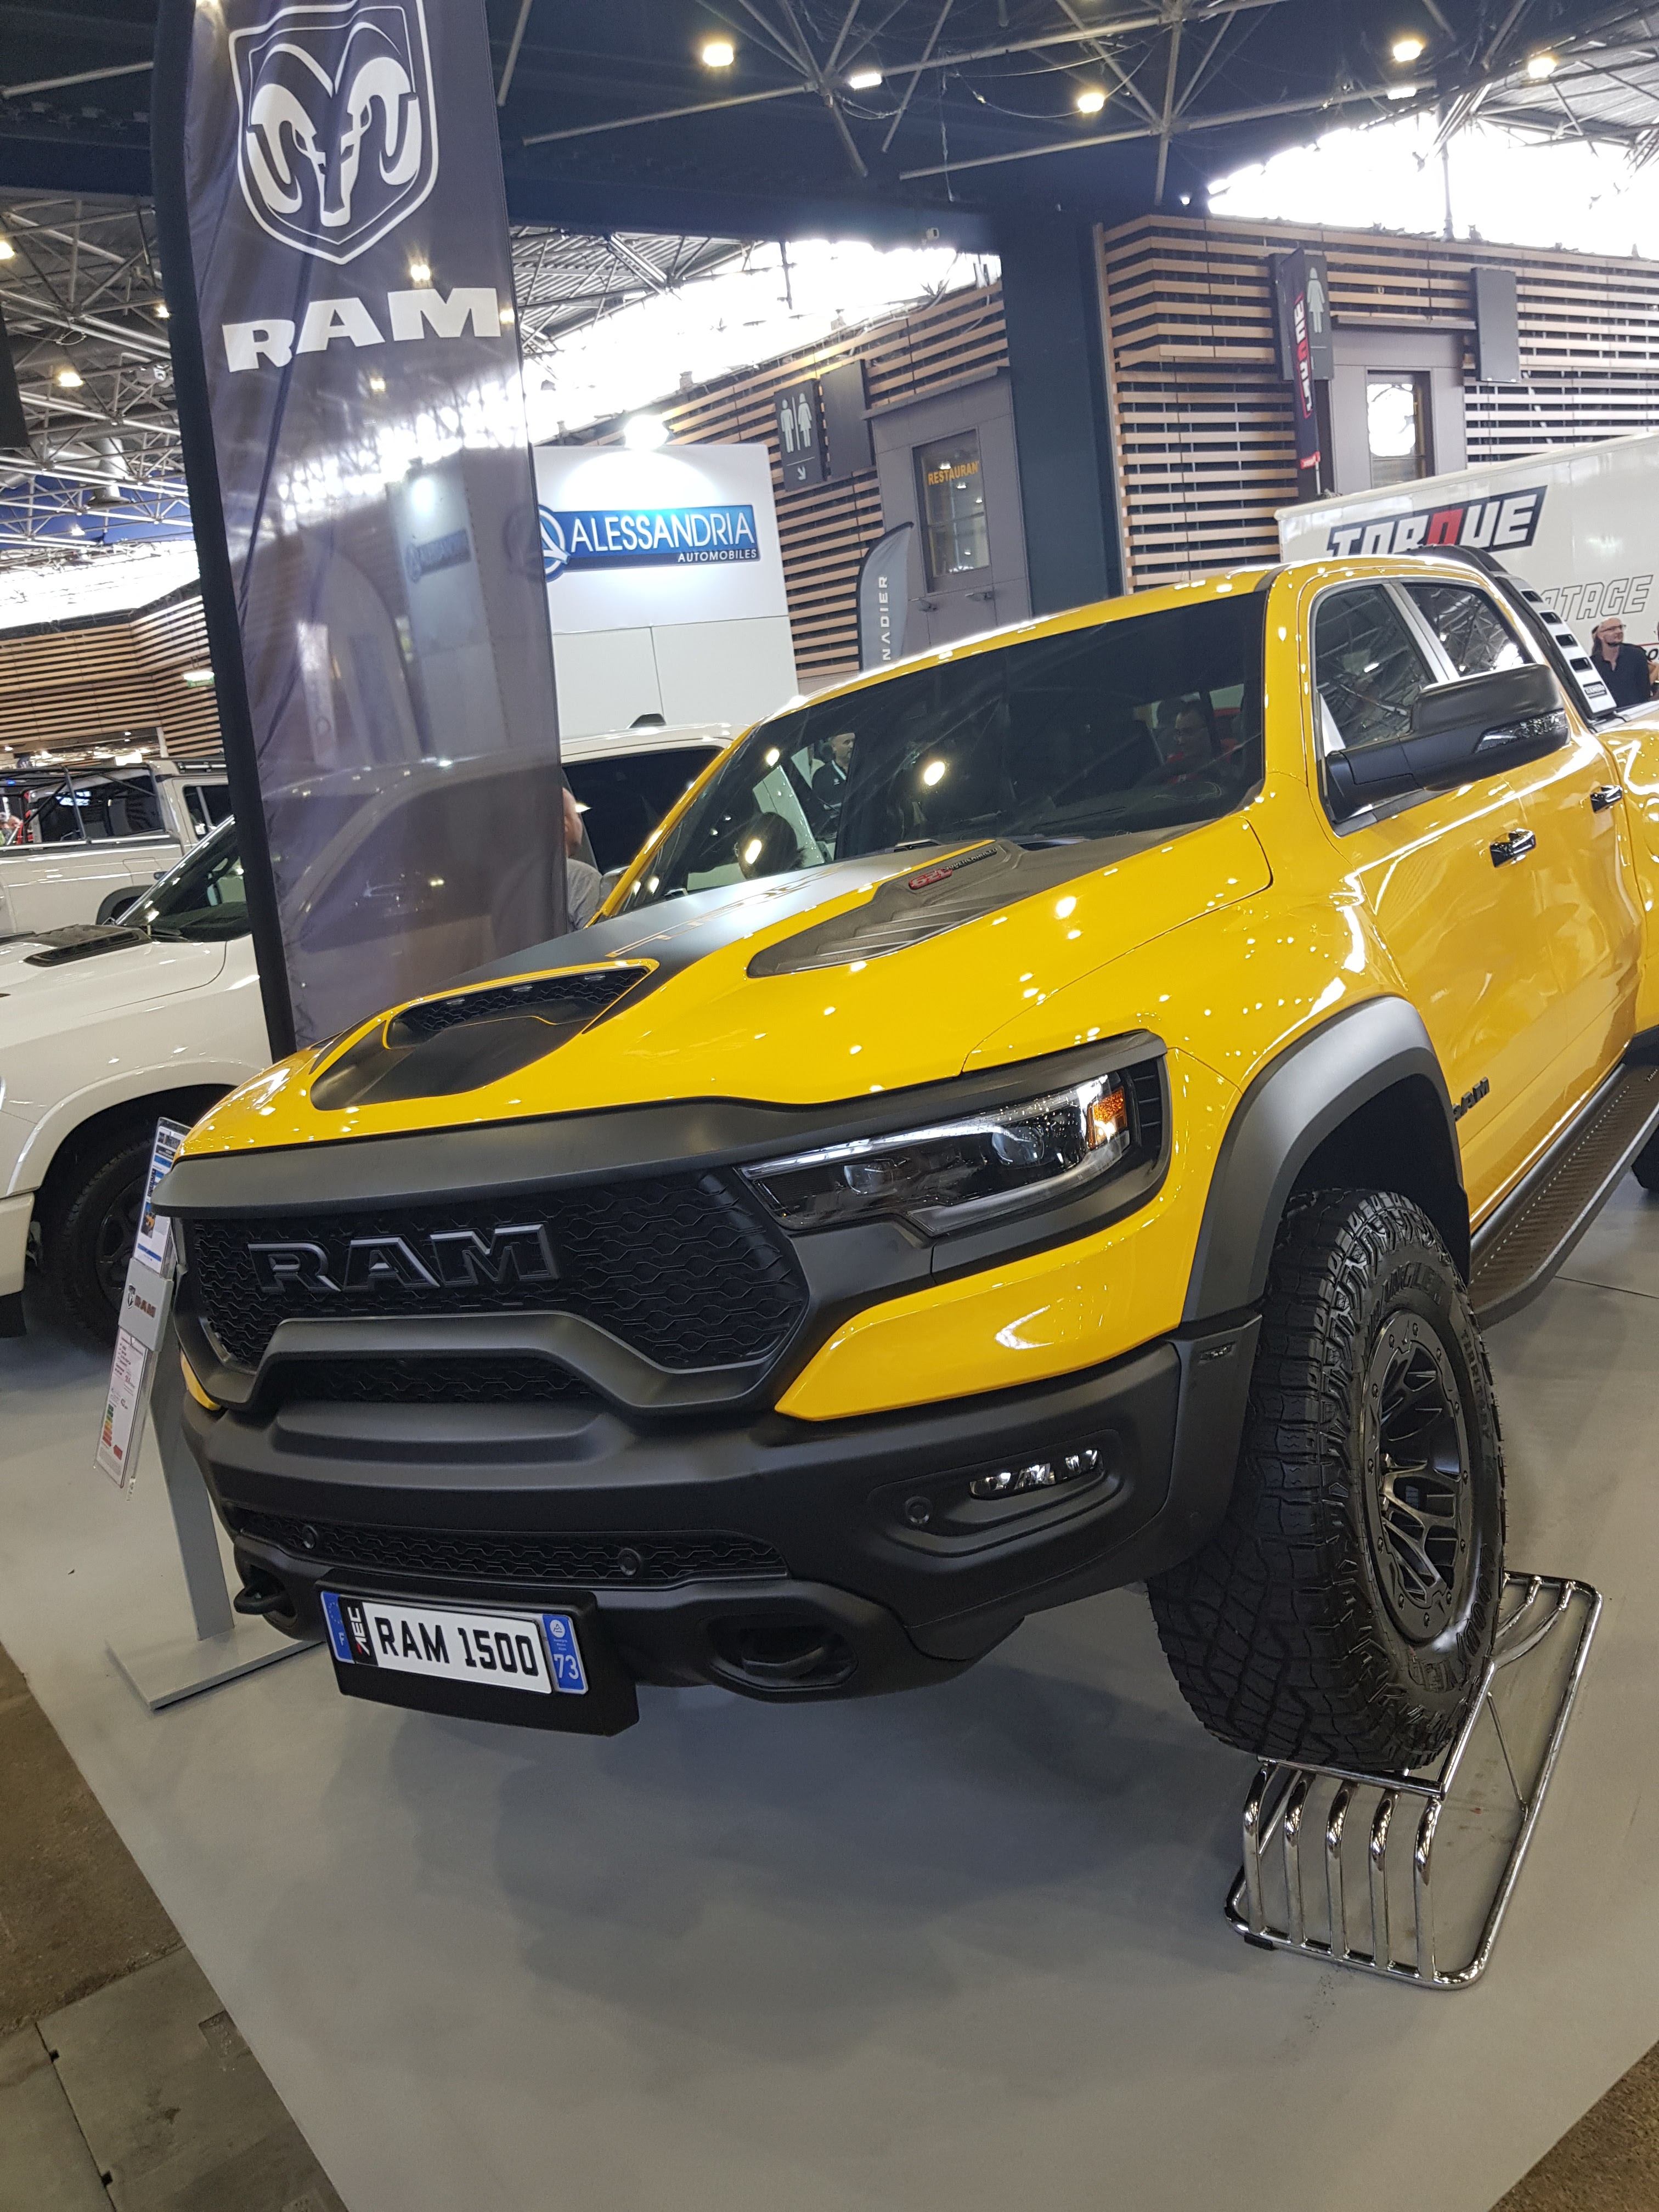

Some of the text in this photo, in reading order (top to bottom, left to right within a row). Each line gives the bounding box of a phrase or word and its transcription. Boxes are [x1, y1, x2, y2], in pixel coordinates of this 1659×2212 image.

[222, 288, 501, 373] RAM
[928, 460, 979, 486] RESTAURAN
[571, 512, 755, 553] ALESSANDRIA
[678, 549, 757, 562] AUTOMOBILES
[248, 1221, 559, 1293] RAM
[134, 1295, 157, 1318] RAM
[338, 1632, 345, 1646] F
[374, 1617, 539, 1677] RAM 1500
[553, 1653, 579, 1680] 73
